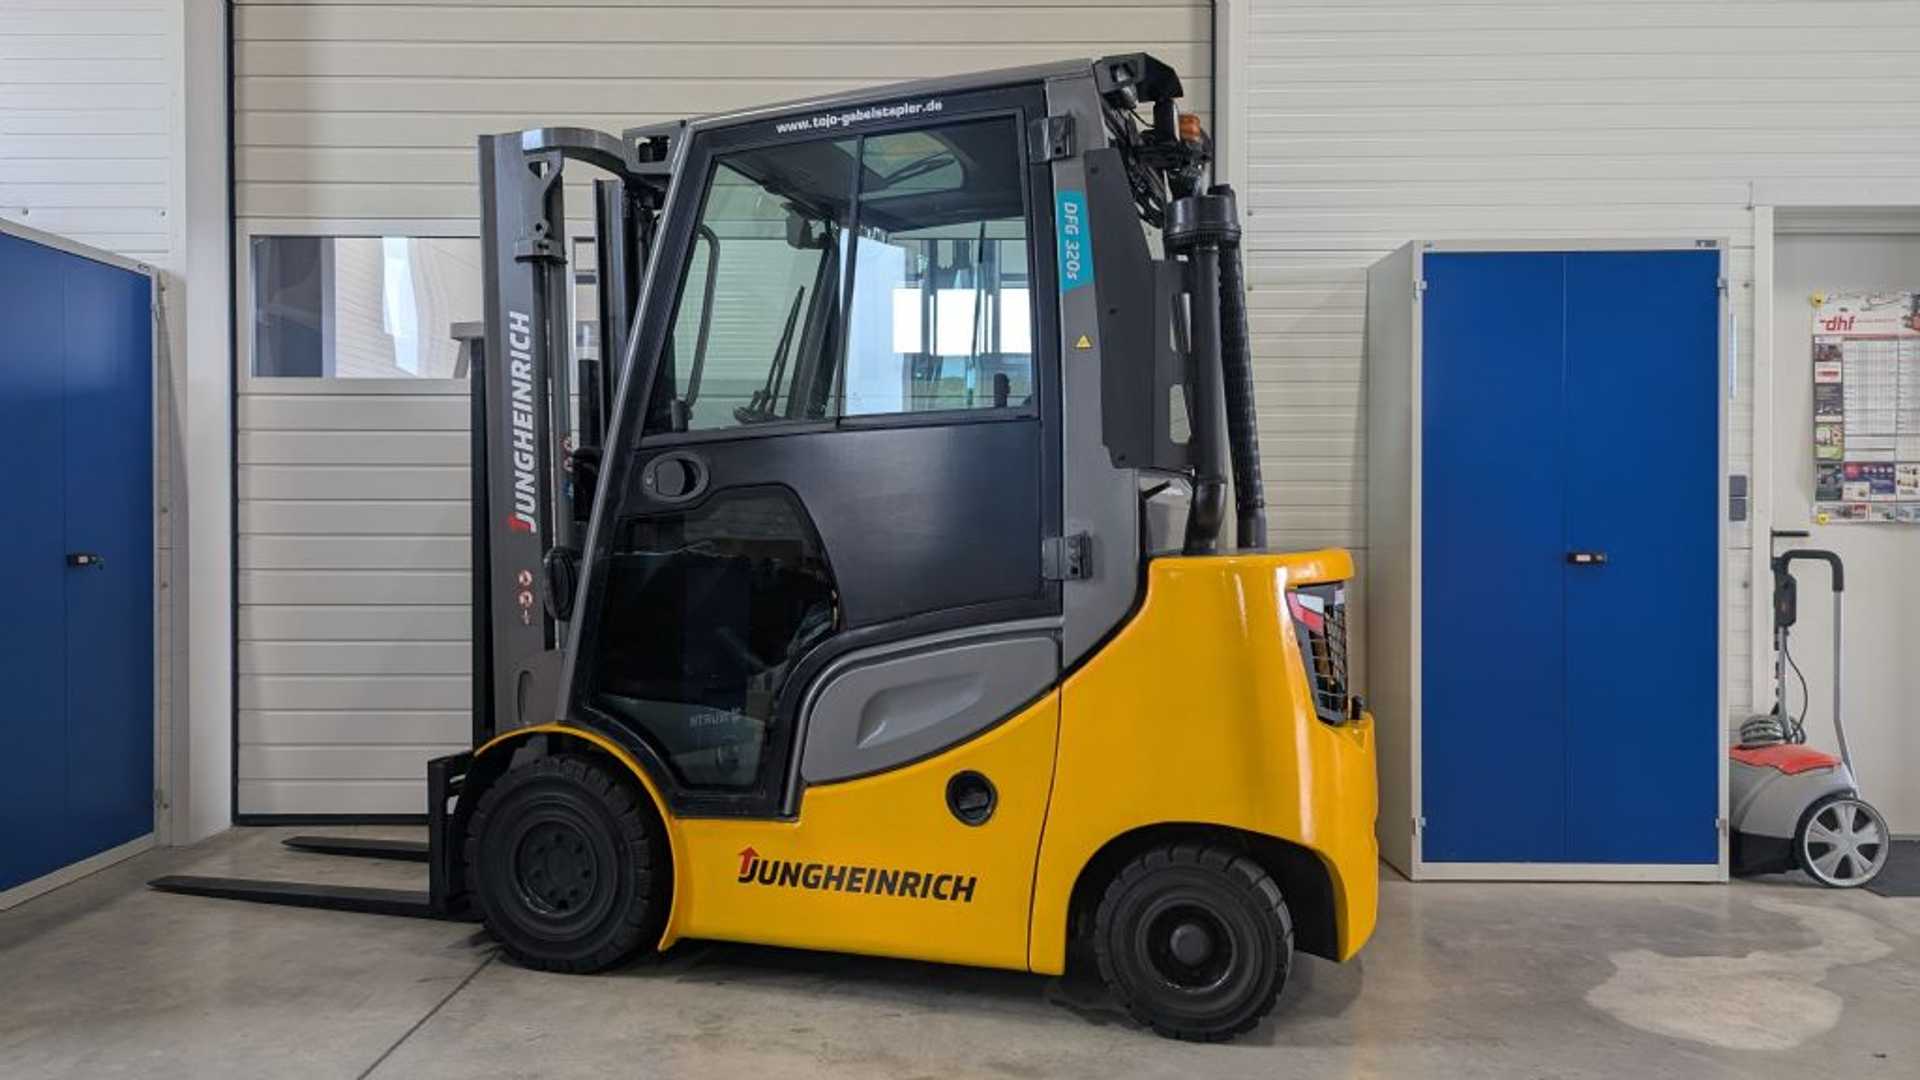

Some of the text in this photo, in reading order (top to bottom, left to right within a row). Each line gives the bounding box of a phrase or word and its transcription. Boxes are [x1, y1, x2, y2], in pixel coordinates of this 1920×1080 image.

[776, 100, 943, 133] www.tojo-gabelstapler.de
[1064, 202, 1079, 235] DFG
[1824, 315, 1855, 331] dhf
[509, 311, 537, 533] JUNGHEINRICH
[737, 857, 977, 903] JUNGHEINRICH
